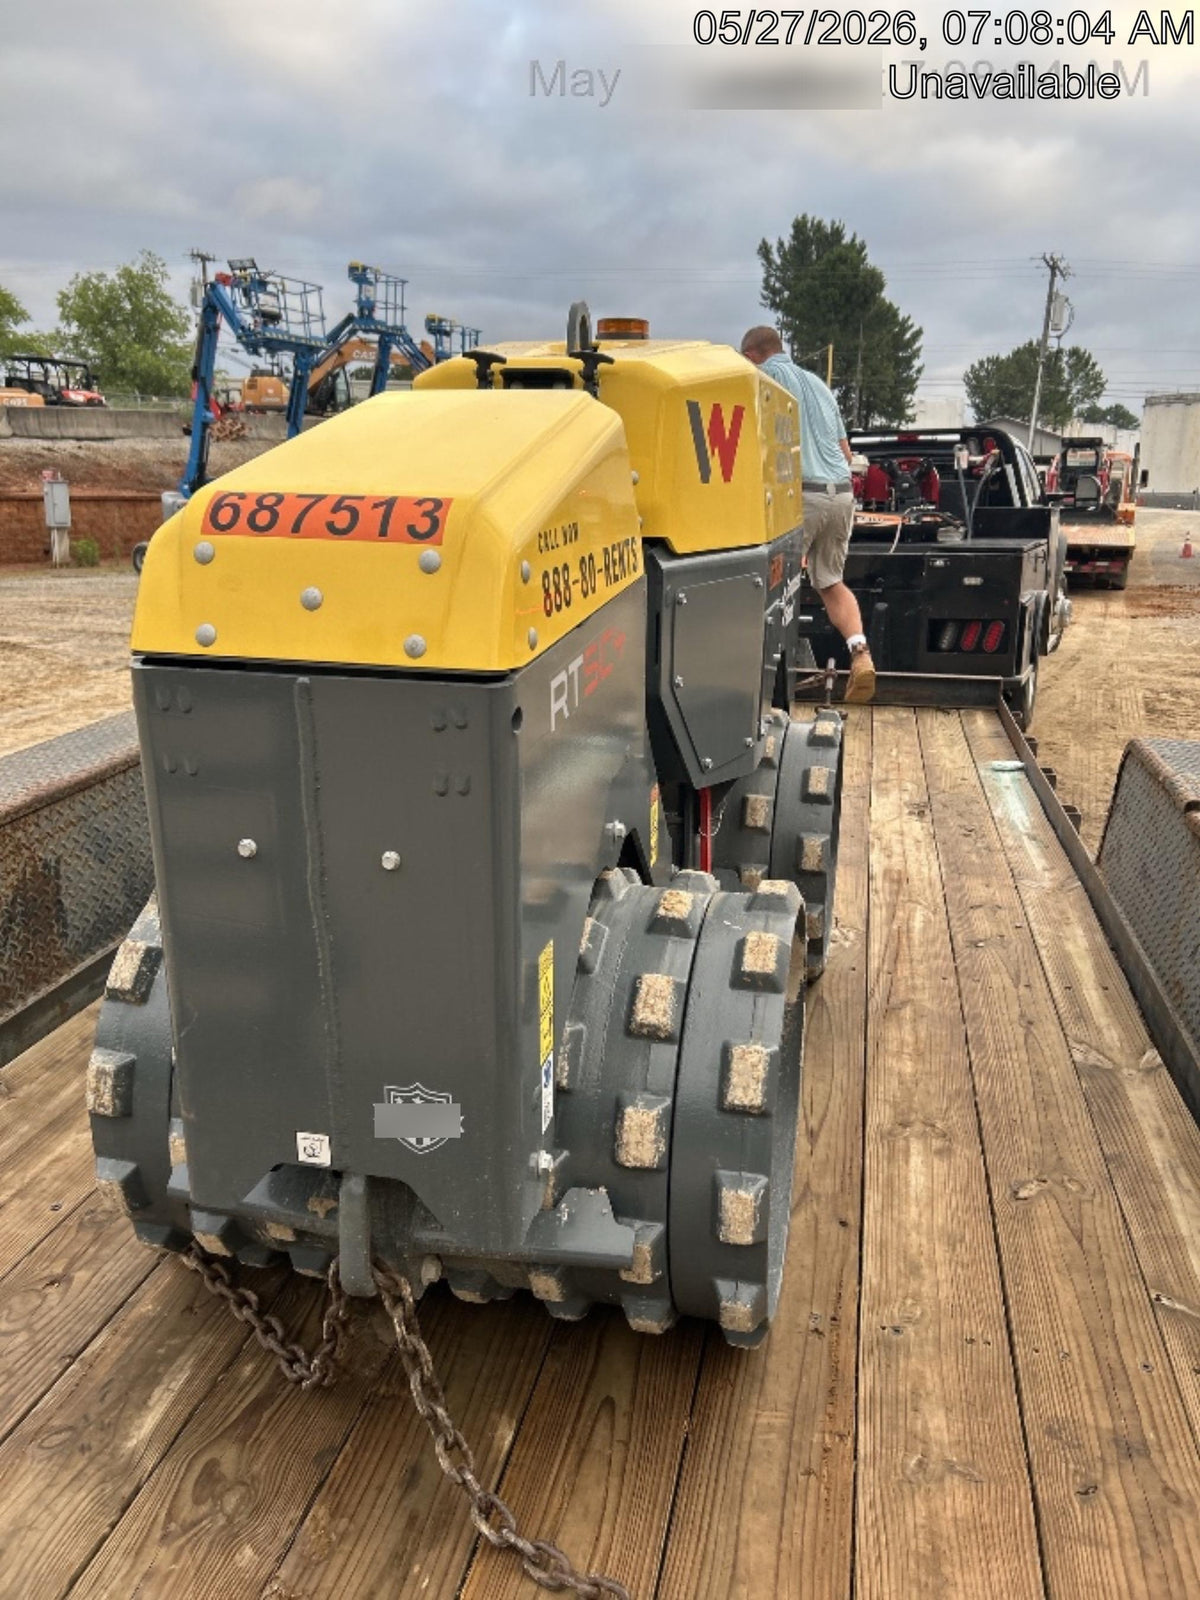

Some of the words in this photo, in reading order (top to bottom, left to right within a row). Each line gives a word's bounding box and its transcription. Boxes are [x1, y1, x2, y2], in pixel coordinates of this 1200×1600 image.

[352, 349, 377, 360] CAS
[209, 492, 439, 541] 687513
[538, 527, 560, 554] CALL
